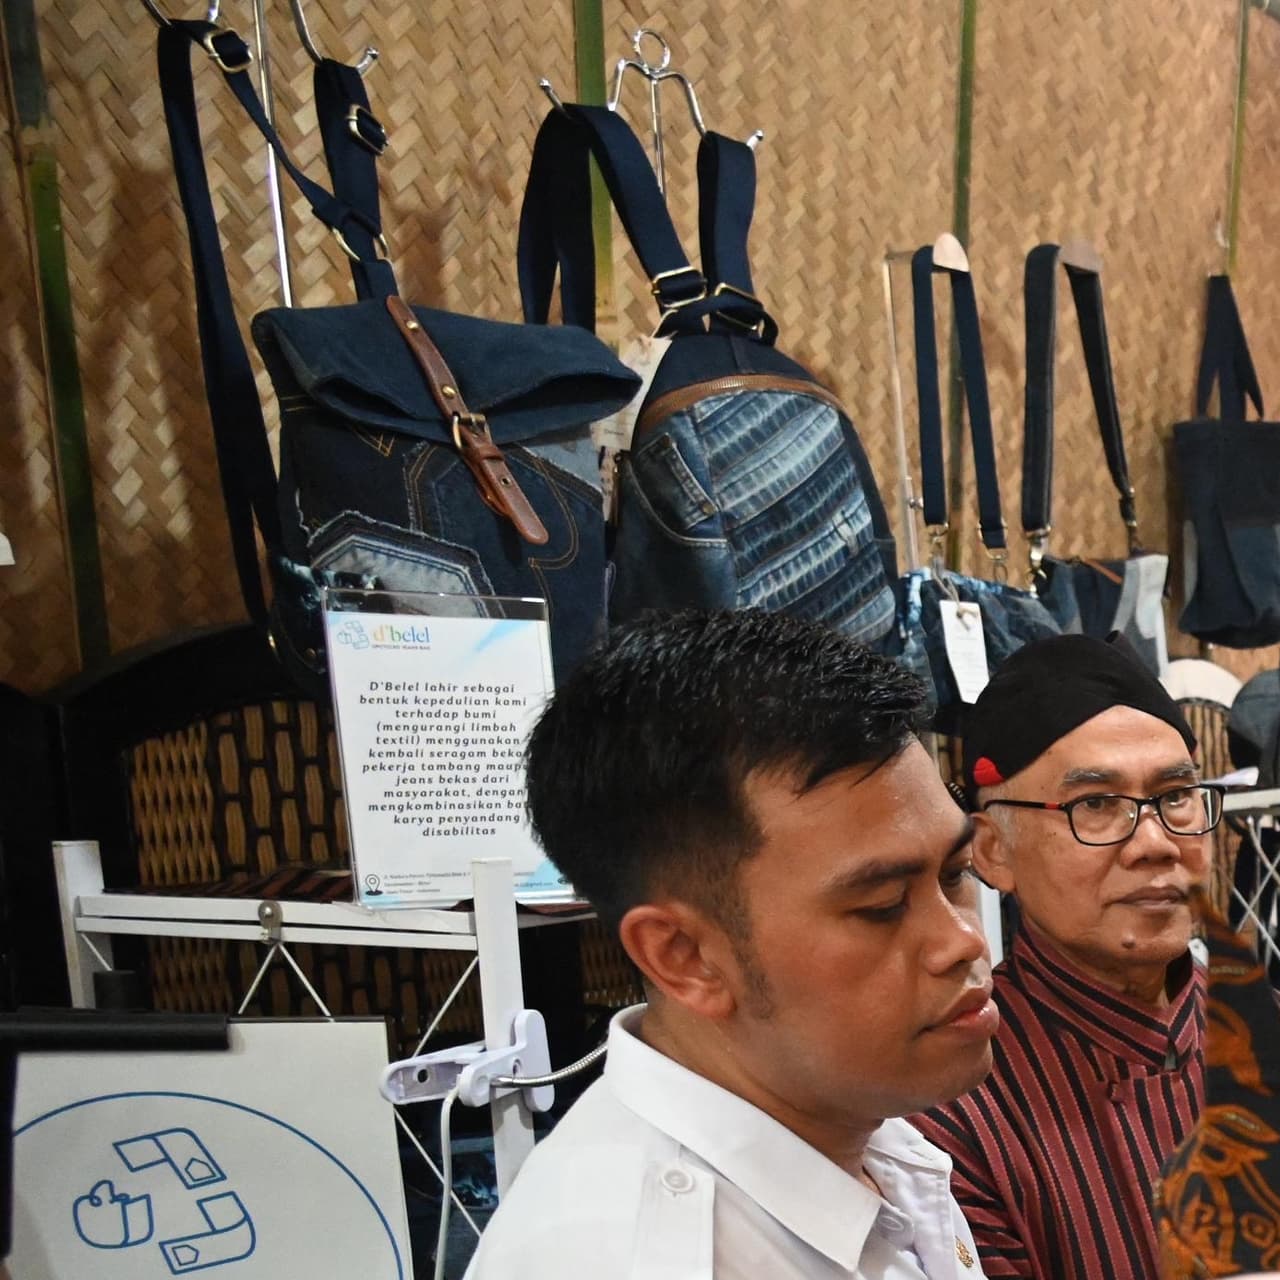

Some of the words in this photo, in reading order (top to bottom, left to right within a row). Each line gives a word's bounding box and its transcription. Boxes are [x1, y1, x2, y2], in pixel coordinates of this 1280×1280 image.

[373, 625, 430, 643] d'belel
[369, 682, 419, 692] D'Belel
[425, 682, 458, 692] lahir
[463, 684, 515, 695] sebagai
[360, 695, 409, 704] bentuk
[414, 696, 489, 707] kepedulian
[495, 697, 527, 706] kami
[395, 709, 459, 720] terhadap
[464, 710, 497, 718] bumi
[376, 722, 466, 734] (mengurangi
[471, 723, 517, 732] limbah
[376, 735, 420, 745] textil)
[426, 736, 520, 747] menggunakan
[369, 750, 424, 758] kembali
[429, 751, 487, 760] seragam
[492, 749, 528, 758] beka
[362, 762, 415, 773] pekerja
[421, 762, 480, 773] tambang
[486, 763, 529, 772] maup
[395, 775, 433, 786] jeans
[439, 775, 478, 784] bekas
[482, 775, 510, 784] dari
[476, 788, 524, 798] dengan
[368, 801, 501, 813] mengkombinasikan
[394, 815, 433, 825] karya
[438, 813, 520, 824] penyandang
[422, 827, 496, 836] disabilitas
